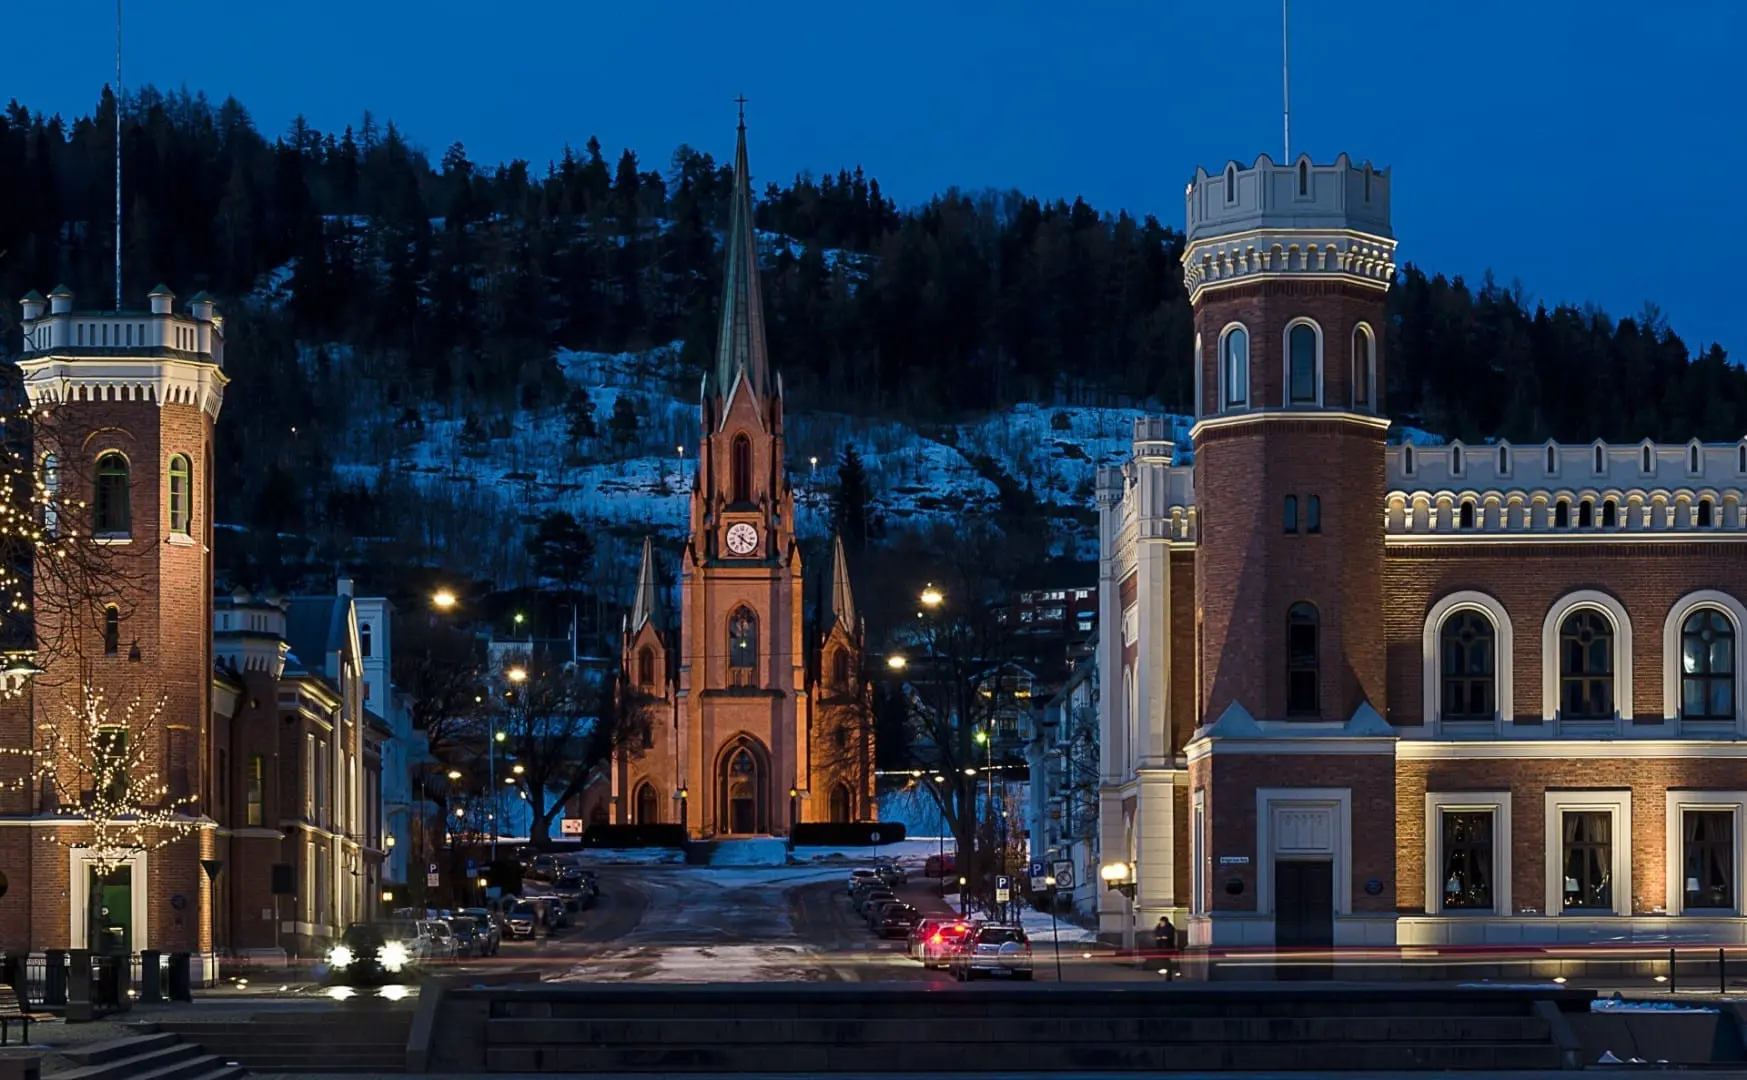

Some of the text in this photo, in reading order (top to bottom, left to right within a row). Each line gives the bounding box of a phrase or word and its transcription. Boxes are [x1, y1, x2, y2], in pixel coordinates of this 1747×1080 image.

[430, 864, 437, 872] P
[1033, 863, 1042, 876] P
[999, 877, 1007, 888] P
